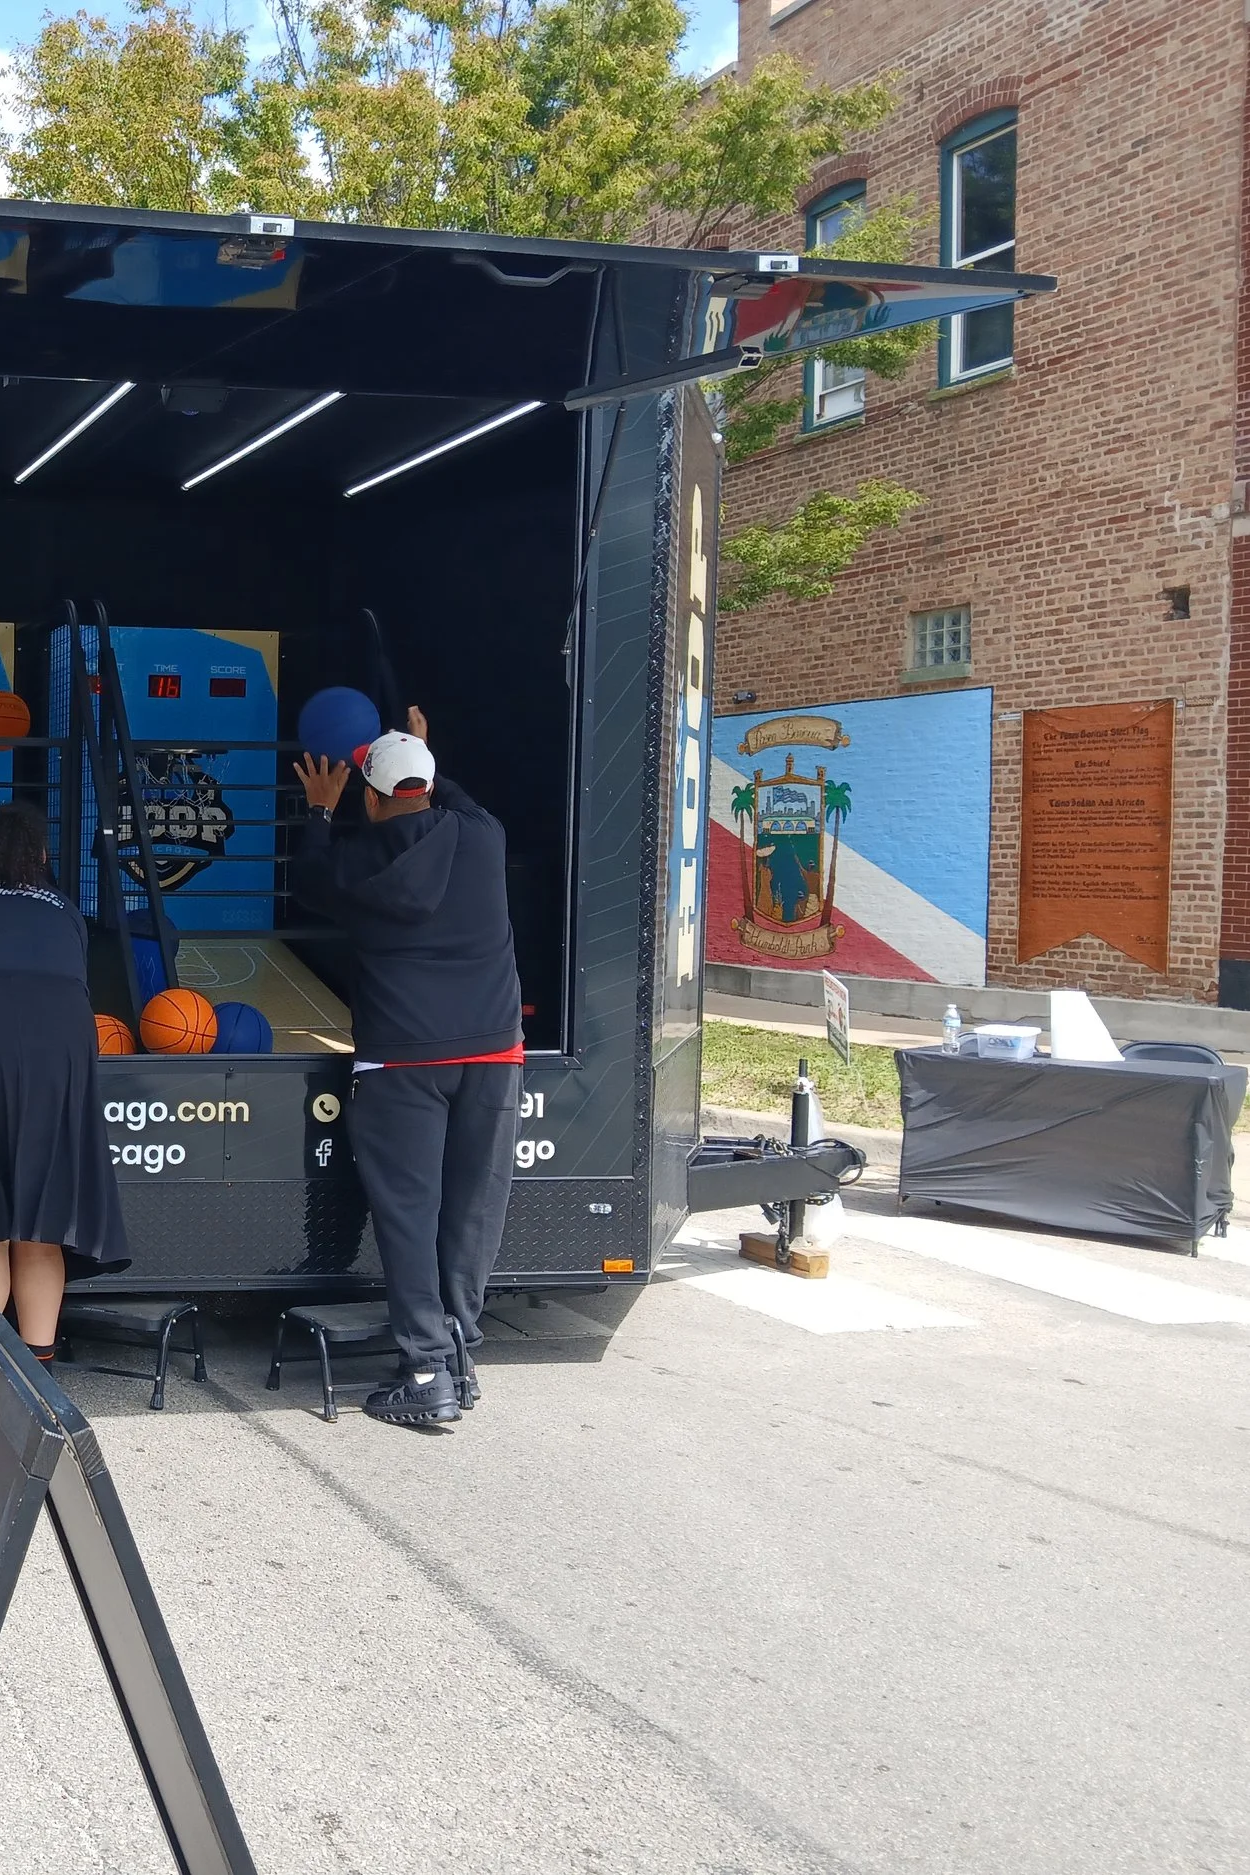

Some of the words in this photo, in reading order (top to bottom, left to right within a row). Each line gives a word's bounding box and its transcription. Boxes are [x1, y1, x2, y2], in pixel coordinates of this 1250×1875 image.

[154, 664, 179, 673] TIME
[210, 665, 247, 674] SCORE
[104, 1101, 250, 1131] ago.com
[515, 1140, 556, 1169] go
